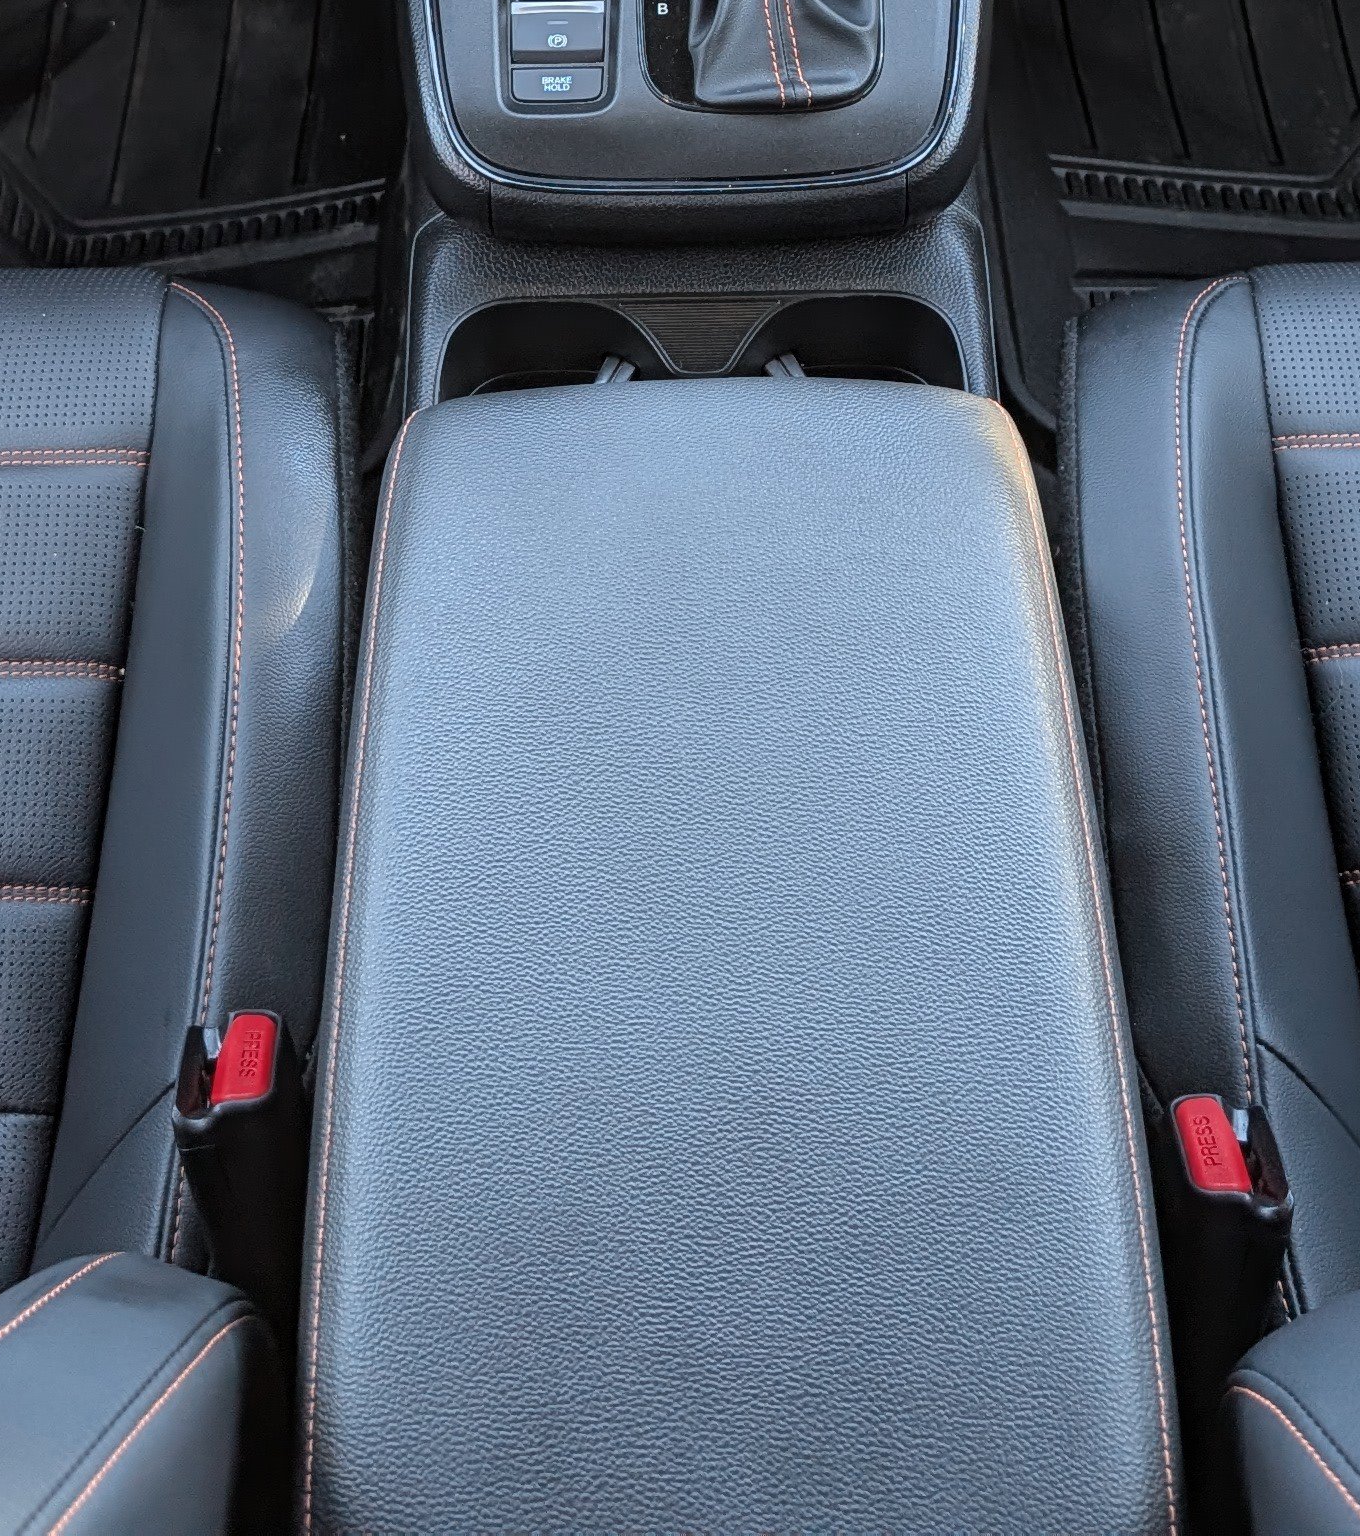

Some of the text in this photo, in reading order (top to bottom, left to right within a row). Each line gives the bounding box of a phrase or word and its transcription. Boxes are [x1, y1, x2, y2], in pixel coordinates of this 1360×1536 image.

[657, 2, 669, 15] B
[541, 75, 573, 84] BRAKE
[543, 83, 570, 92] HOLD
[239, 1030, 262, 1078] PRESS
[1192, 1115, 1223, 1167] PRESS
